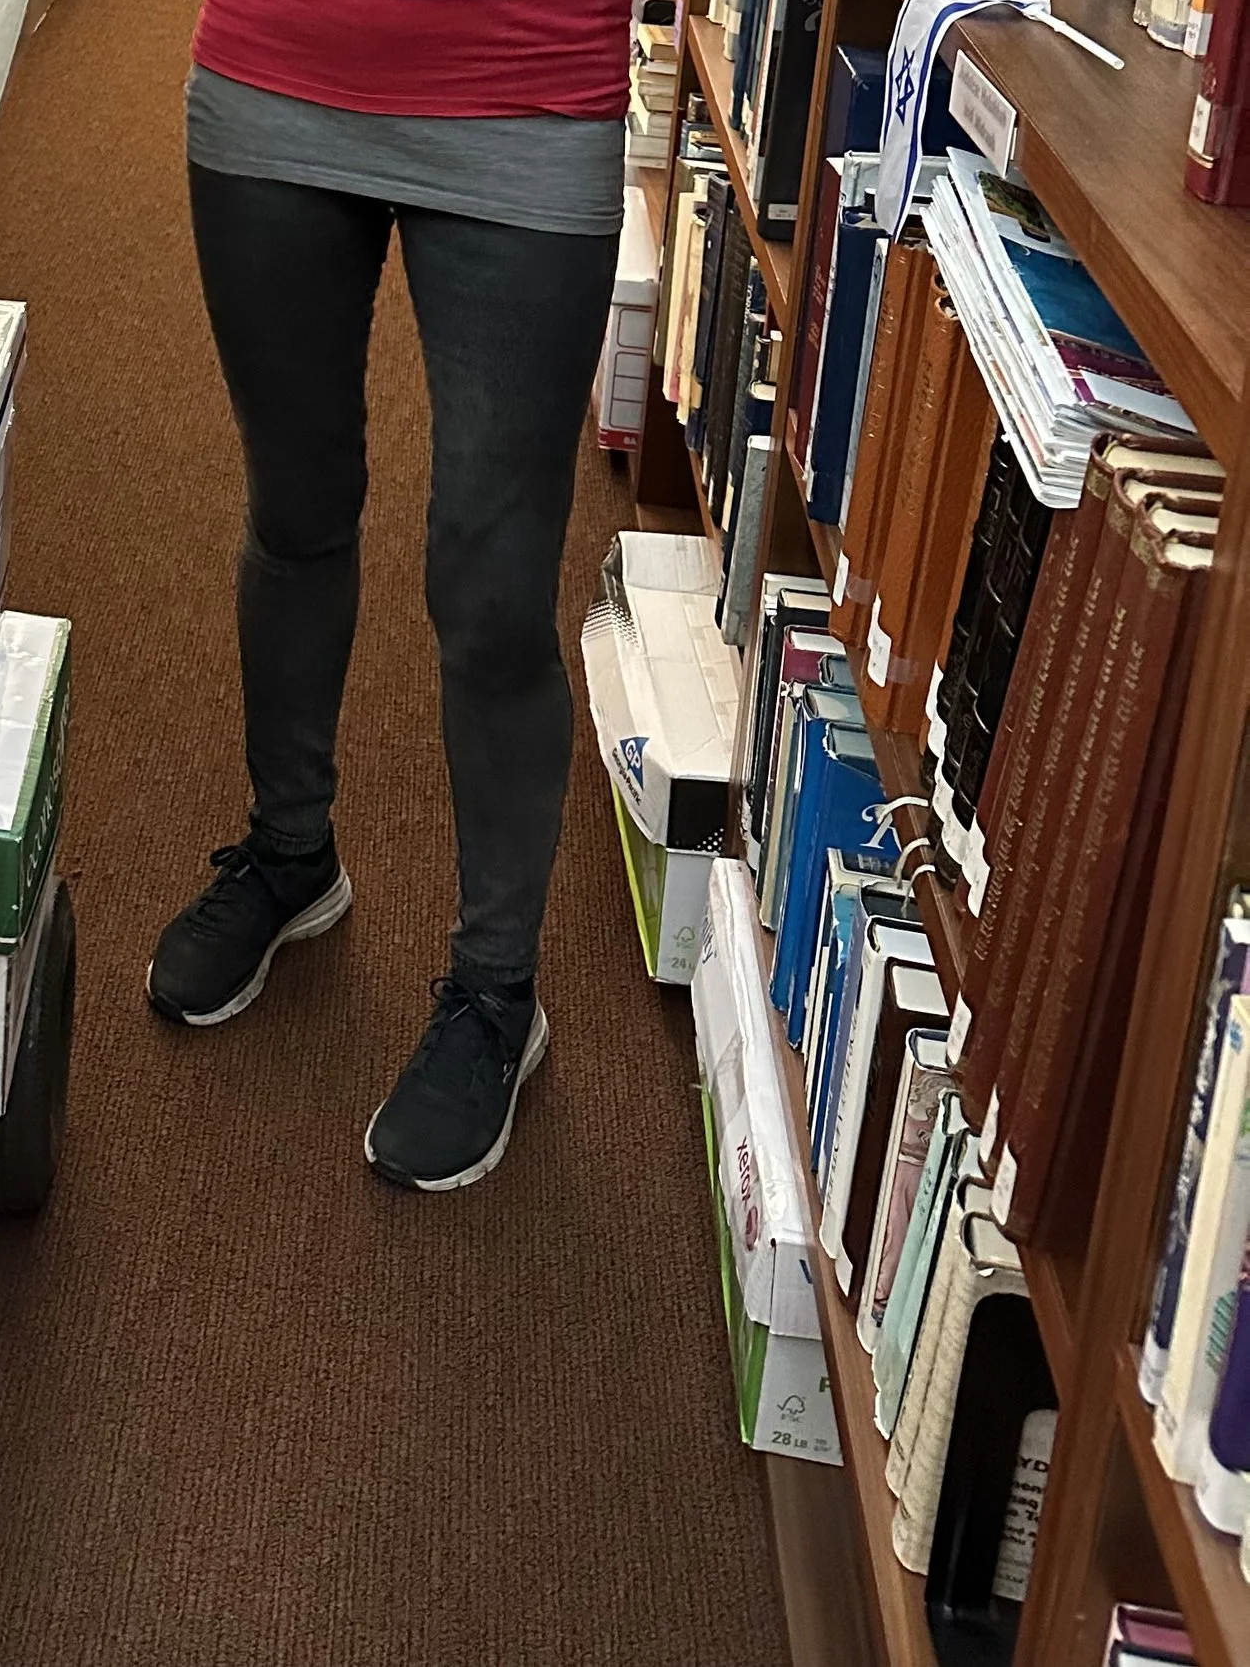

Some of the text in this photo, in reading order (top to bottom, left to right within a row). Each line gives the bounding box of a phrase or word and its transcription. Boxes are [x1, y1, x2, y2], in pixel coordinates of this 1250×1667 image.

[625, 739, 642, 769] GP
[737, 1135, 751, 1210] xerox
[771, 1430, 792, 1446] 28
